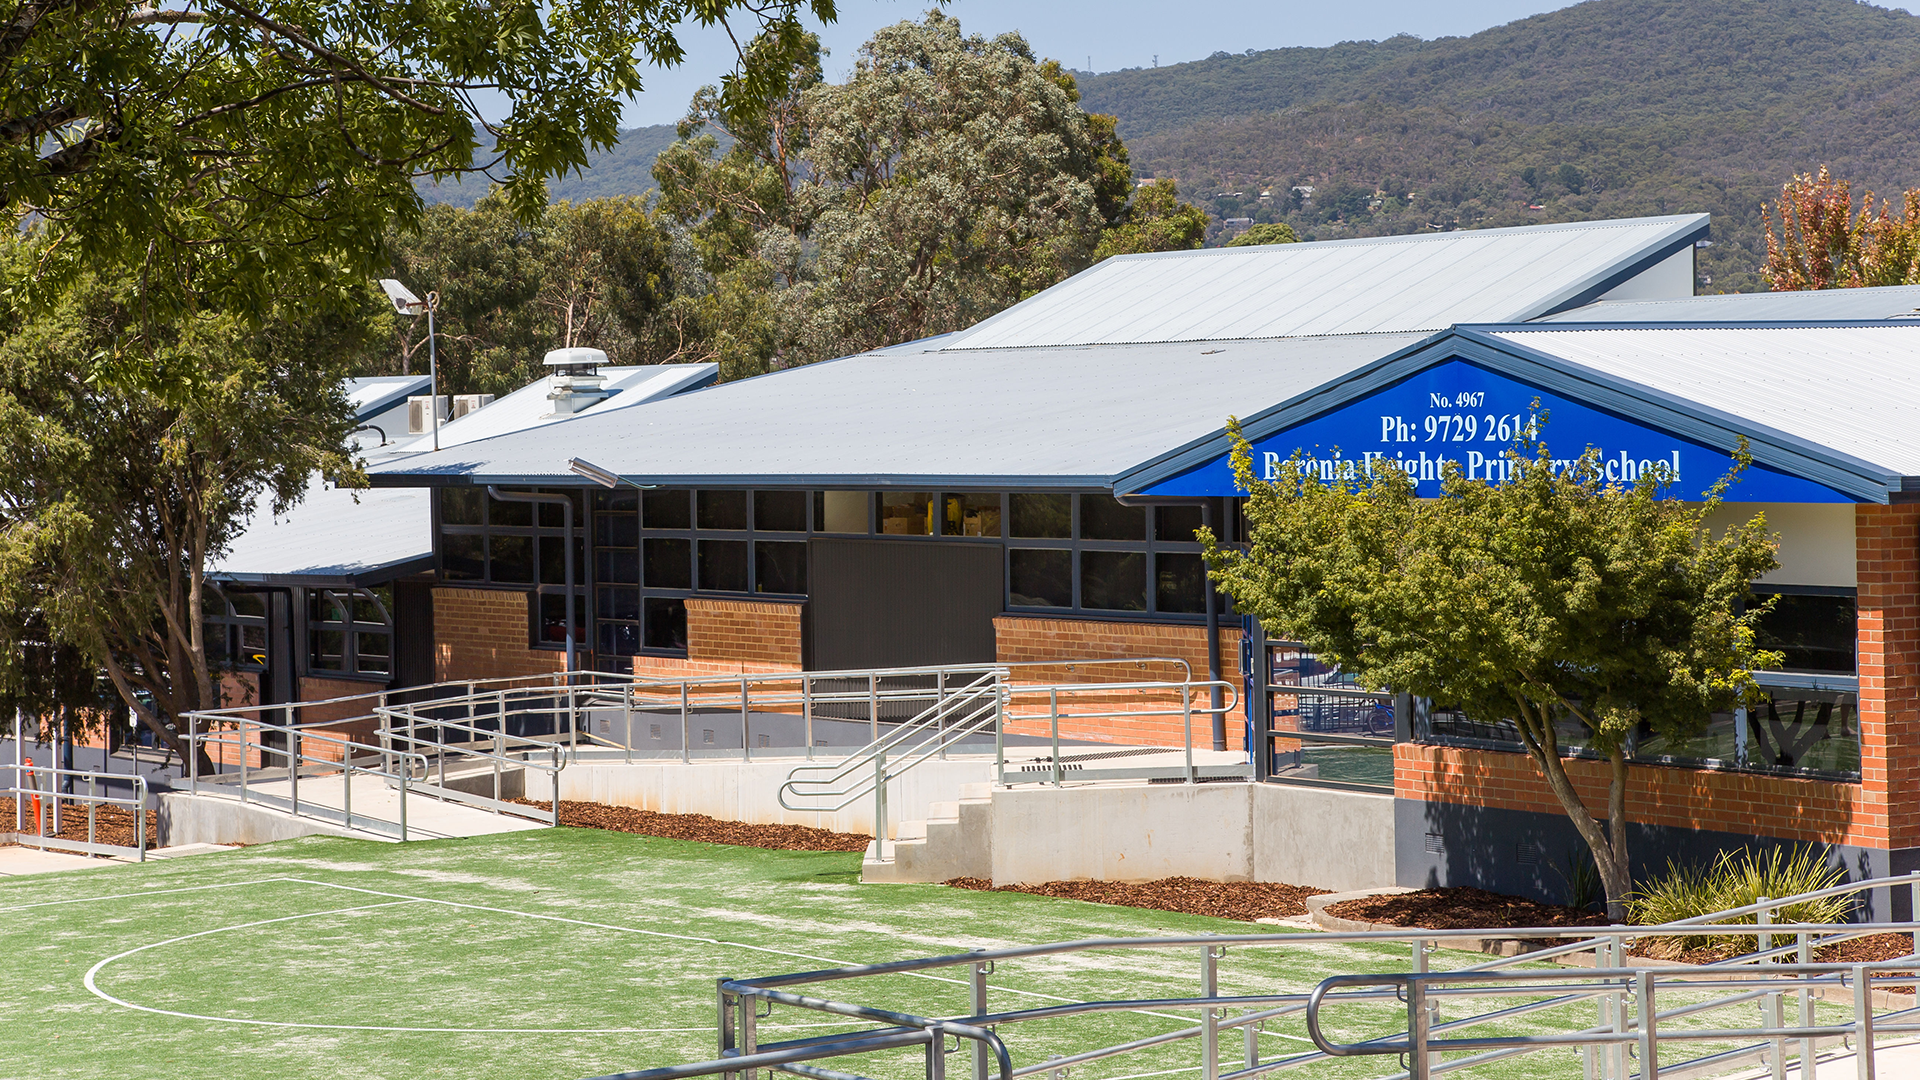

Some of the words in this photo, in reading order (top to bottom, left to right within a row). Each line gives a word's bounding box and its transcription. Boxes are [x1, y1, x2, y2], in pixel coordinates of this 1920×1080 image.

[1429, 391, 1452, 408] No.
[1455, 391, 1485, 408] 4967
[1380, 415, 1417, 442] Ph:
[1424, 414, 1478, 442] 9729
[1483, 413, 1538, 442] 2614
[1586, 449, 1682, 482] School
